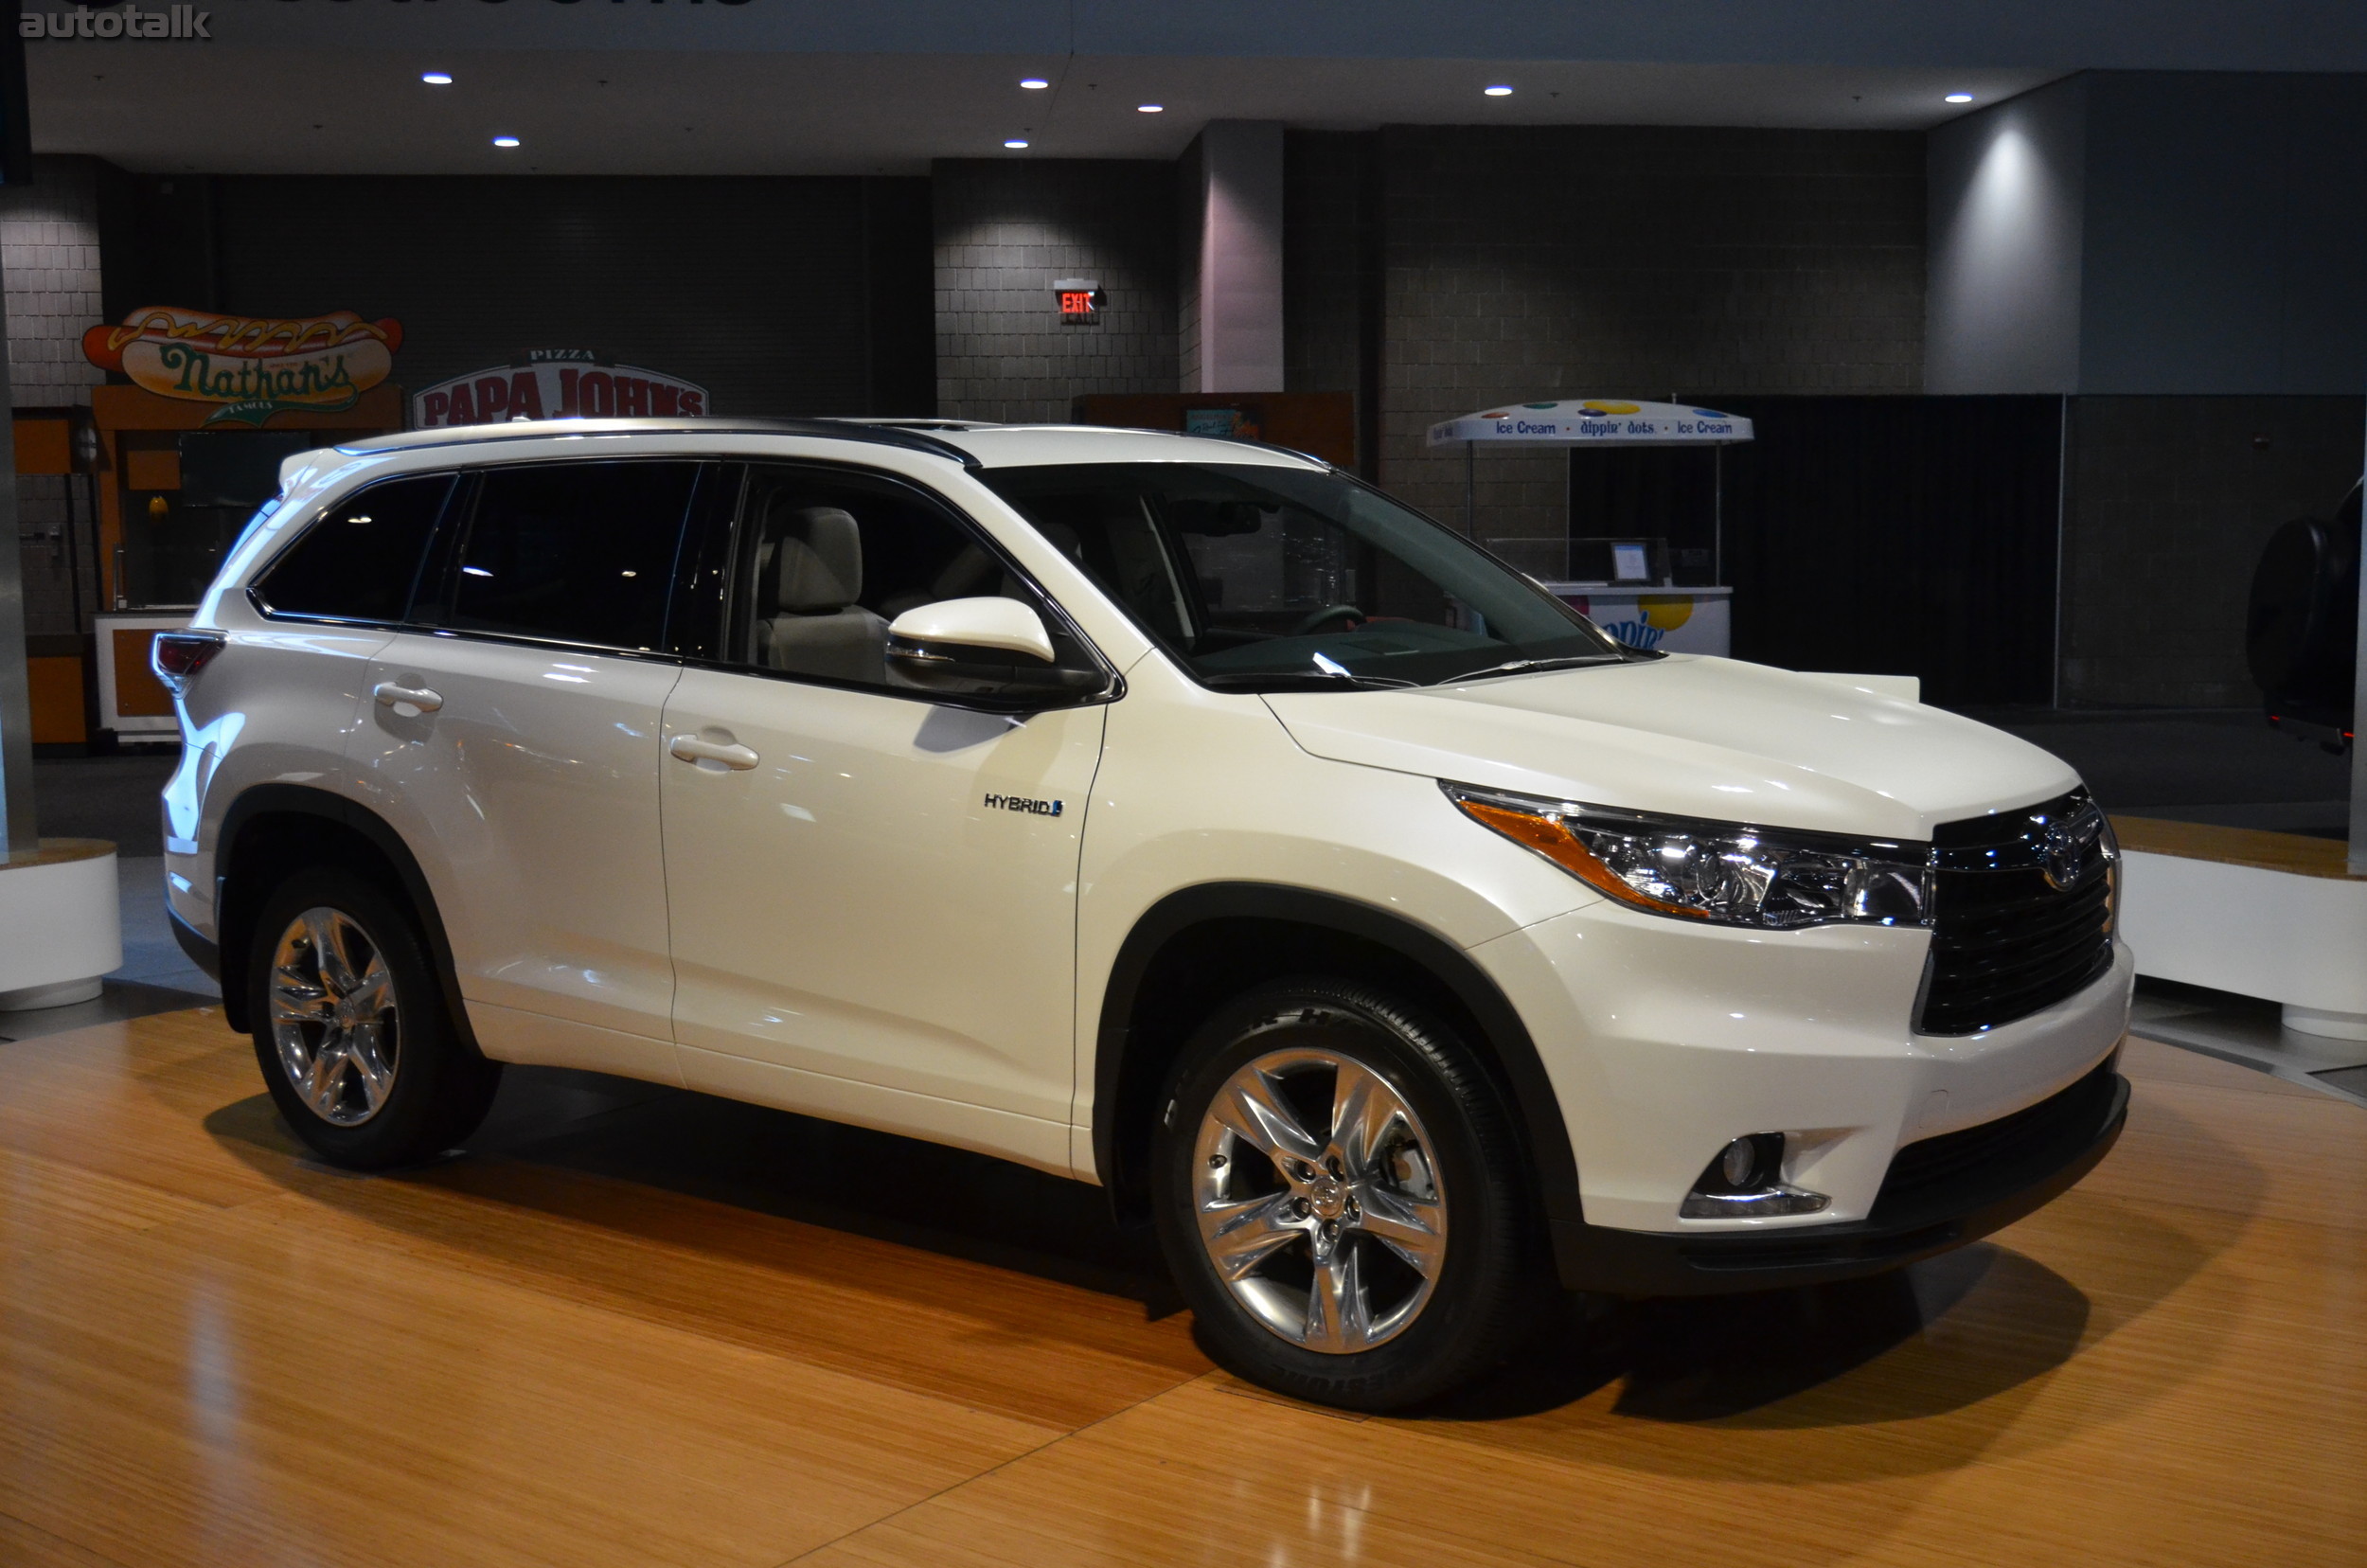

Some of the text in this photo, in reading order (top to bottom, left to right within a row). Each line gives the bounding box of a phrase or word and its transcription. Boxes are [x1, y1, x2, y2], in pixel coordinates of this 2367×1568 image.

[1061, 293, 1092, 313] EXIT
[529, 348, 596, 361] PIZZA
[160, 342, 350, 400] Nathan's
[423, 368, 703, 426] PAPA JOHN'S
[229, 401, 274, 414] FAMOUS
[1496, 420, 1556, 435] Ice Cream
[1628, 421, 1654, 435] dots
[1678, 420, 1733, 434] Ice Cream
[984, 793, 1050, 815] HYBRID
